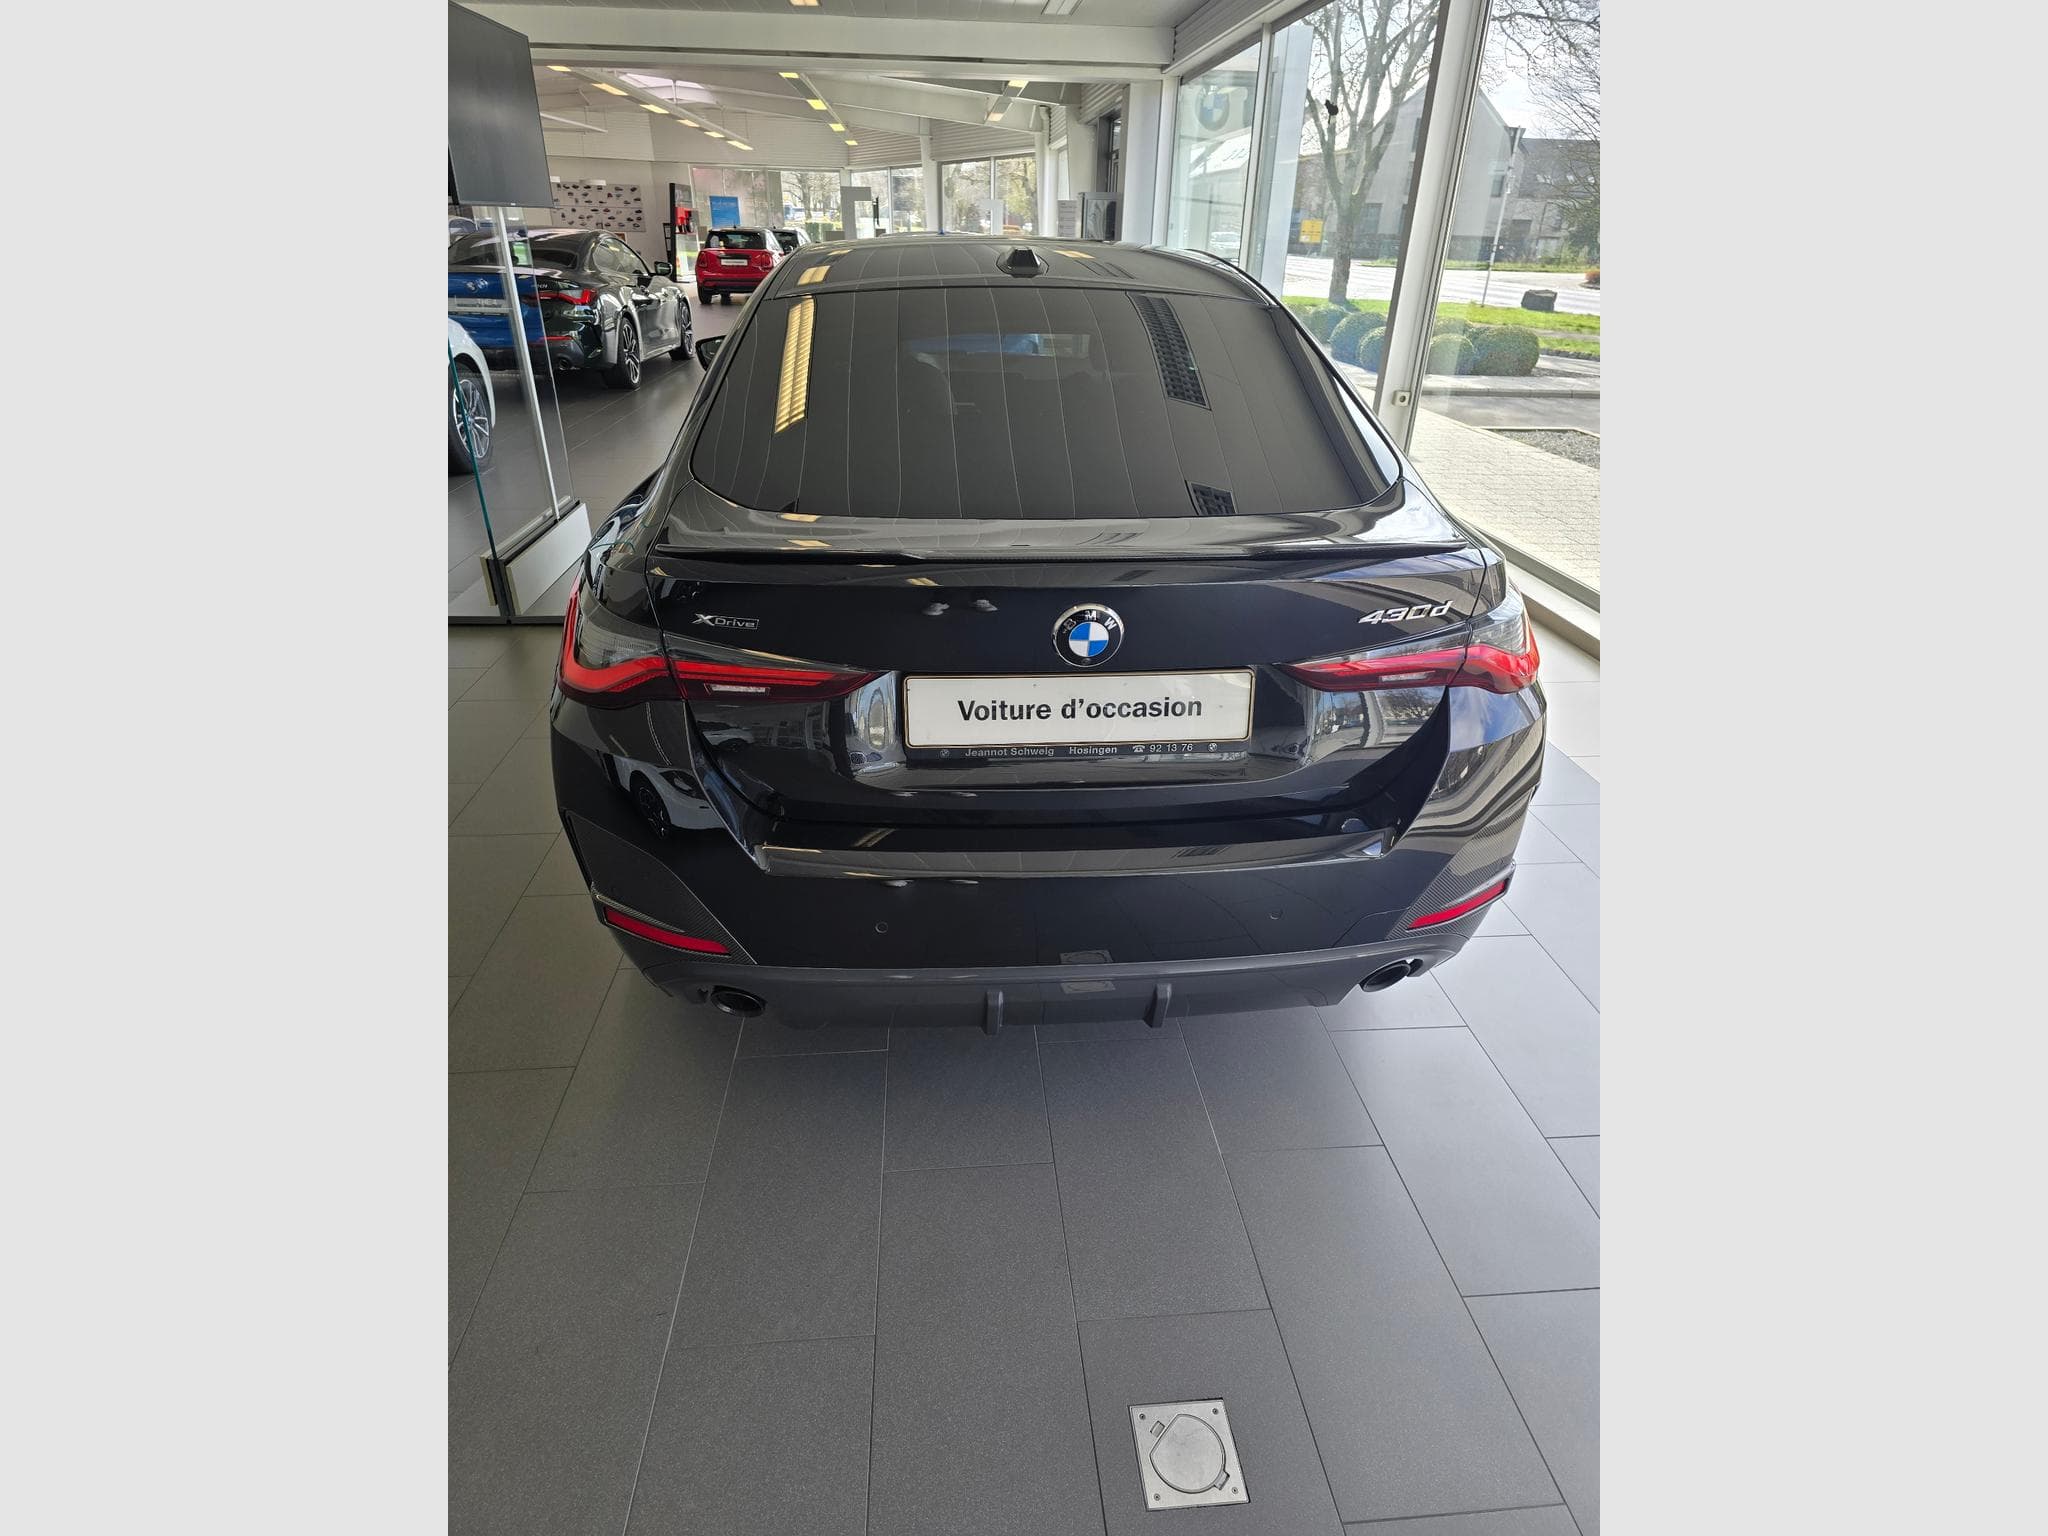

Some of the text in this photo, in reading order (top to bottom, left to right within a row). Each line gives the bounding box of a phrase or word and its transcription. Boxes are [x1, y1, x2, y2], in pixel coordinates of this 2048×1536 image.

[1063, 609, 1118, 631] BMW
[1357, 600, 1453, 625] 430d
[957, 697, 1202, 721] Voiture d'occasion
[965, 747, 1008, 757] Jeannot
[1068, 745, 1118, 756] Hosingen
[1149, 744, 1162, 753] 92
[1167, 743, 1178, 752] 13
[1181, 743, 1193, 752] 76
